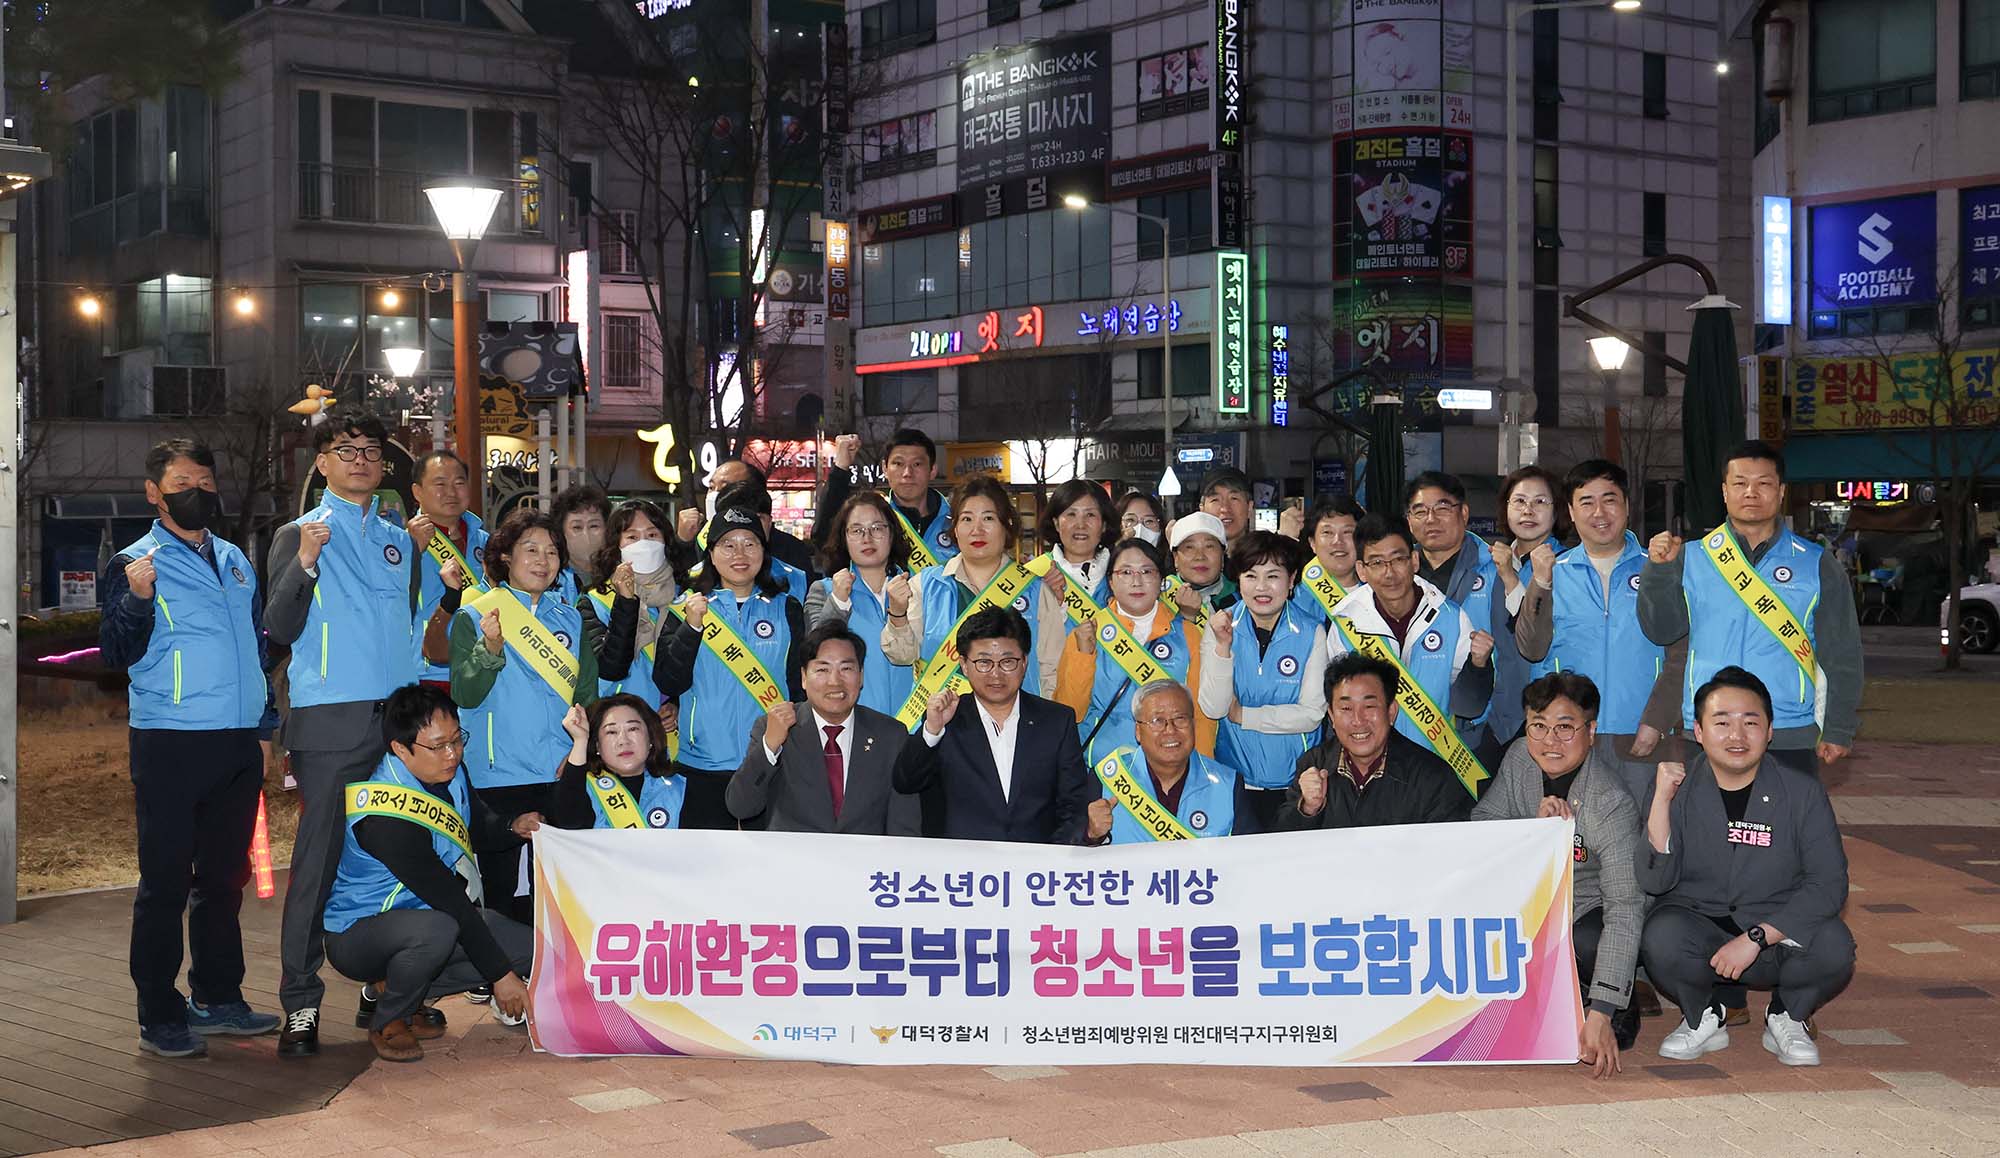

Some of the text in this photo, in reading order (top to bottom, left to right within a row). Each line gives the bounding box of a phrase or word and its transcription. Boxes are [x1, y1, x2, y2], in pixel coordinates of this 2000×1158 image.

[975, 70, 1004, 93] THE
[964, 92, 1093, 151] 태국전통 마사지
[1451, 108, 1471, 124] 24H
[1221, 128, 1239, 147] 4F
[1091, 147, 1105, 160] 4F
[1375, 160, 1416, 168] STADIUM
[830, 177, 843, 213] 마사지
[908, 207, 927, 226] 홀덤
[1445, 246, 1468, 269] 3F
[830, 247, 849, 313] 부동산
[1838, 267, 1915, 287] FOOTBALL
[1837, 280, 1913, 301] ACADEMY
[1077, 301, 1182, 342] 노래연습장
[1087, 444, 1120, 461] HAIR
[1717, 548, 1800, 639] 학교폭력
[1727, 828, 1773, 847] 조대웅
[868, 867, 1220, 908] 청소년이 안전한 세상
[589, 913, 1527, 998] 유해환경으로부터 청소년을 보호합시다
[784, 1023, 1339, 1045] 대덕구 대덕경찰서 청소년범죄예방위원 대전대덕구지구위원회
